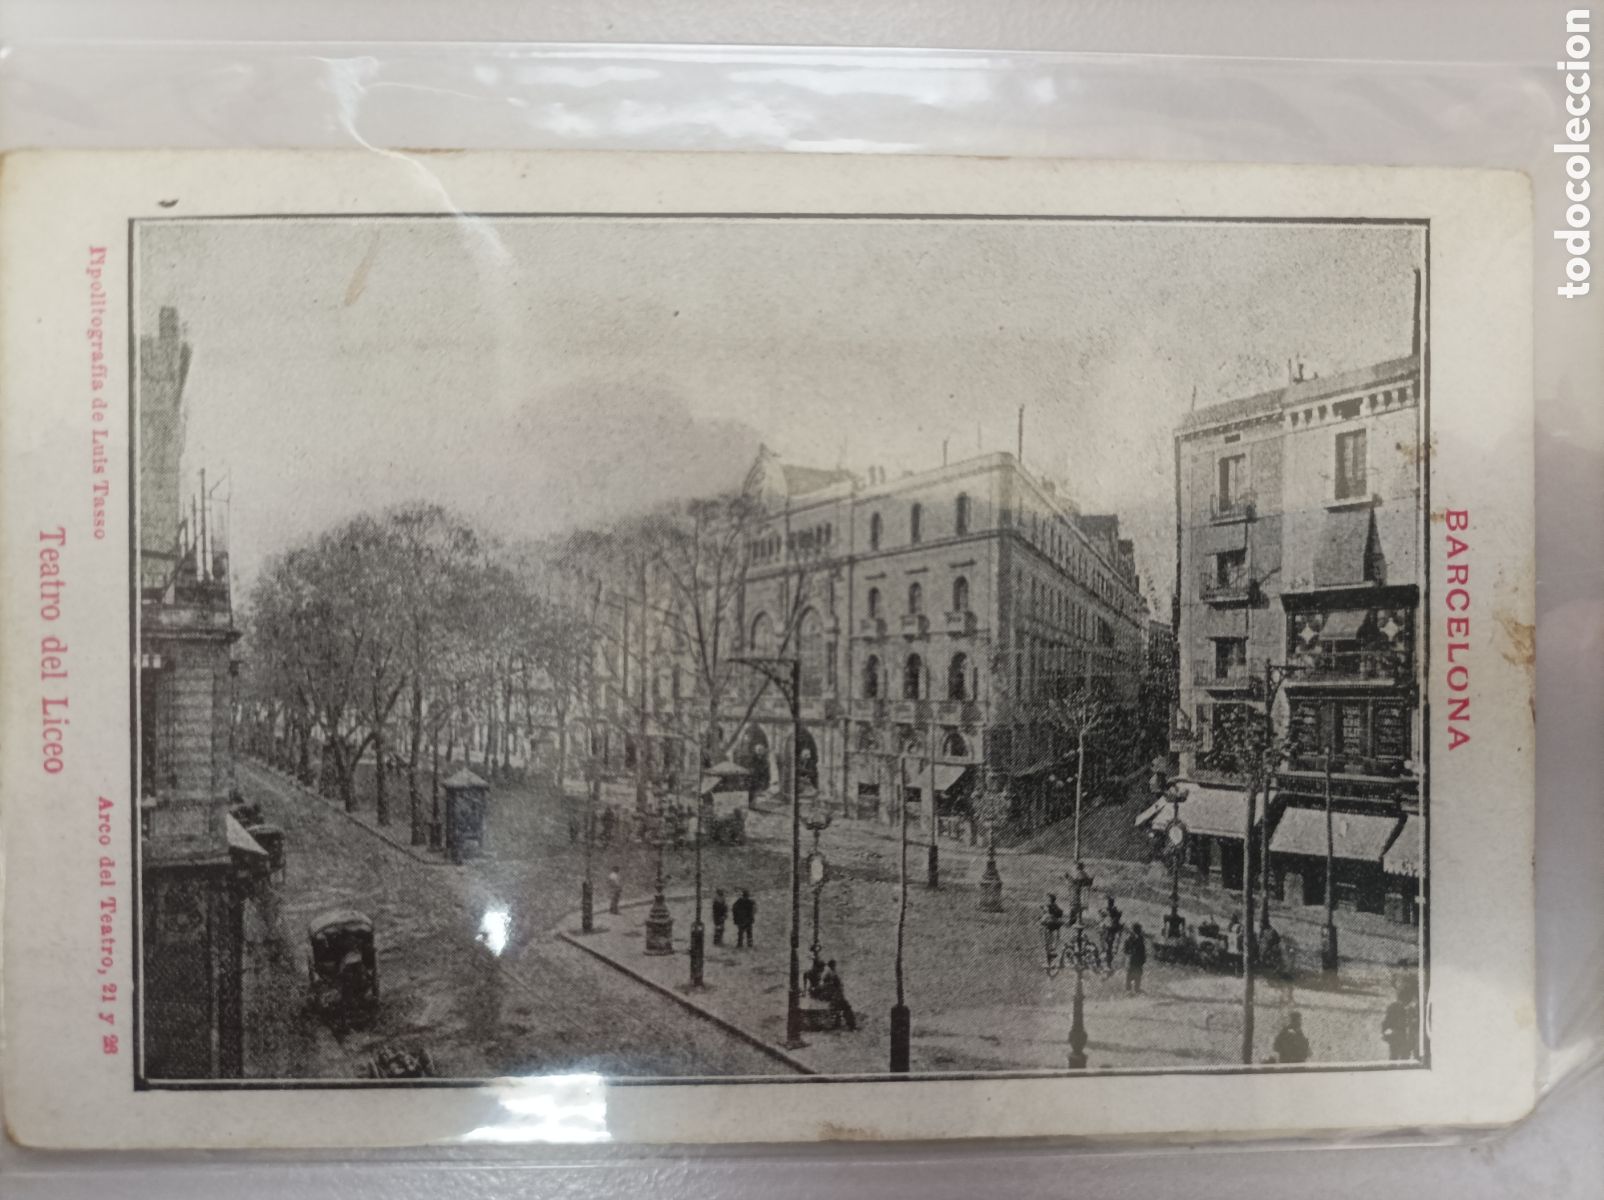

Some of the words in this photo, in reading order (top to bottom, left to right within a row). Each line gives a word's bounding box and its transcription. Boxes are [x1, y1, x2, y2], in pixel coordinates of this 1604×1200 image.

[92, 397, 108, 422] de
[92, 429, 109, 475] Luis
[93, 479, 110, 540] Tasso
[38, 526, 67, 623] Teatro
[1444, 508, 1472, 752] BARCELONA
[40, 635, 69, 682] del
[41, 697, 71, 775] Liceo
[97, 796, 115, 846] Arco
[99, 856, 116, 887] del
[97, 896, 117, 975] Teatro,
[101, 983, 118, 1003] 21
[98, 1012, 116, 1025] y
